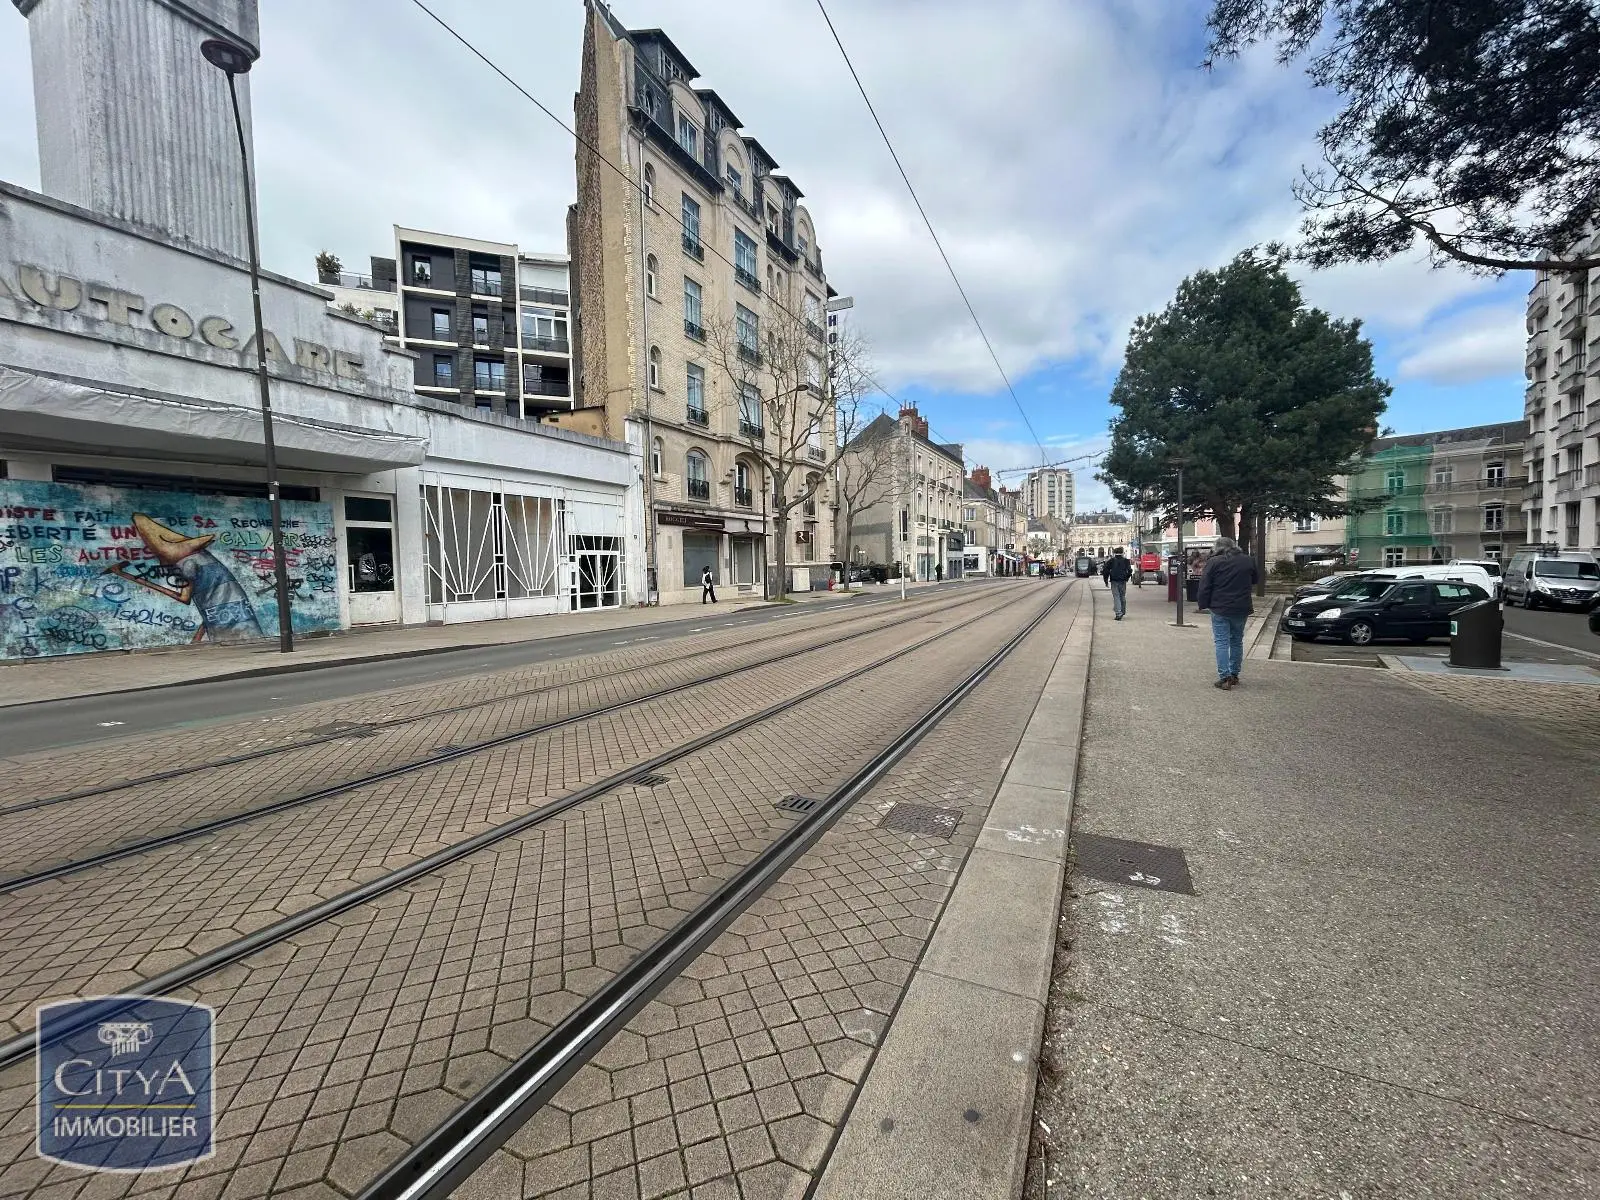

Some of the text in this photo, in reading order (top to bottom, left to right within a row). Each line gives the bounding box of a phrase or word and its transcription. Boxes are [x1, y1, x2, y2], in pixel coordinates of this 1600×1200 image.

[168, 516, 188, 527] DE
[192, 514, 219, 528] SA
[231, 517, 300, 529] RECHECHE
[0, 523, 97, 540] IBERTÉ
[15, 544, 158, 564] LES AUTRES
